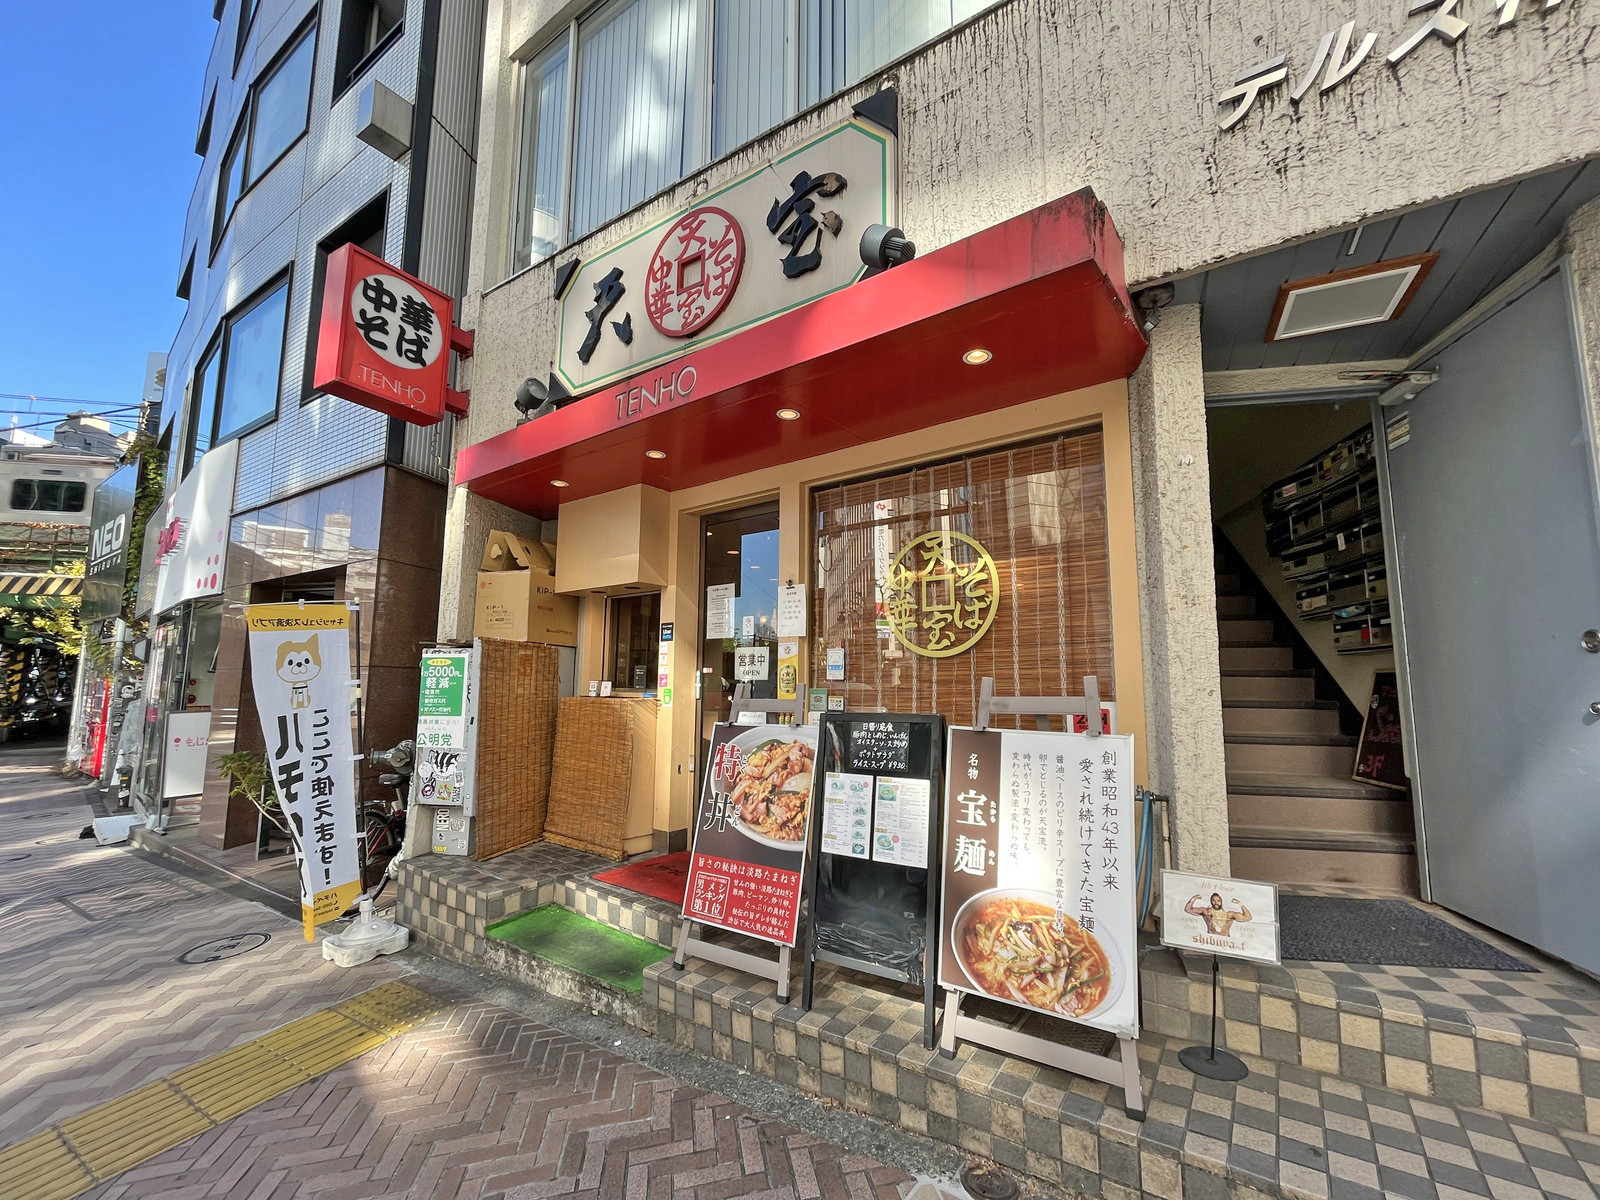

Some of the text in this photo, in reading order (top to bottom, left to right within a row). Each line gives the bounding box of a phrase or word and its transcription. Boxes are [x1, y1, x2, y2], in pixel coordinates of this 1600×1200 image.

[704, 223, 737, 300] そば
[362, 277, 436, 335] 中華
[649, 255, 675, 325] 中華
[358, 362, 427, 404] TENHO
[615, 365, 698, 420] TENHO
[91, 513, 126, 561] NEO
[888, 563, 918, 636] 中華
[953, 557, 994, 630] そば
[738, 653, 766, 667] 営業中
[425, 677, 450, 689] 軽減
[417, 732, 453, 746] 公明党
[967, 752, 979, 780] 名物
[436, 808, 450, 831] NERO
[953, 789, 988, 877] 宝麺
[1101, 750, 1120, 891] 創業昭和43年以来
[1078, 757, 1096, 934] 愛され続けてきた宝麺
[697, 856, 798, 886] 旨さの秘訣は淡路たまねぎ
[693, 898, 722, 916] 第1位
[695, 888, 725, 903] ランキング
[744, 901, 791, 918] たっぷりの具材と
